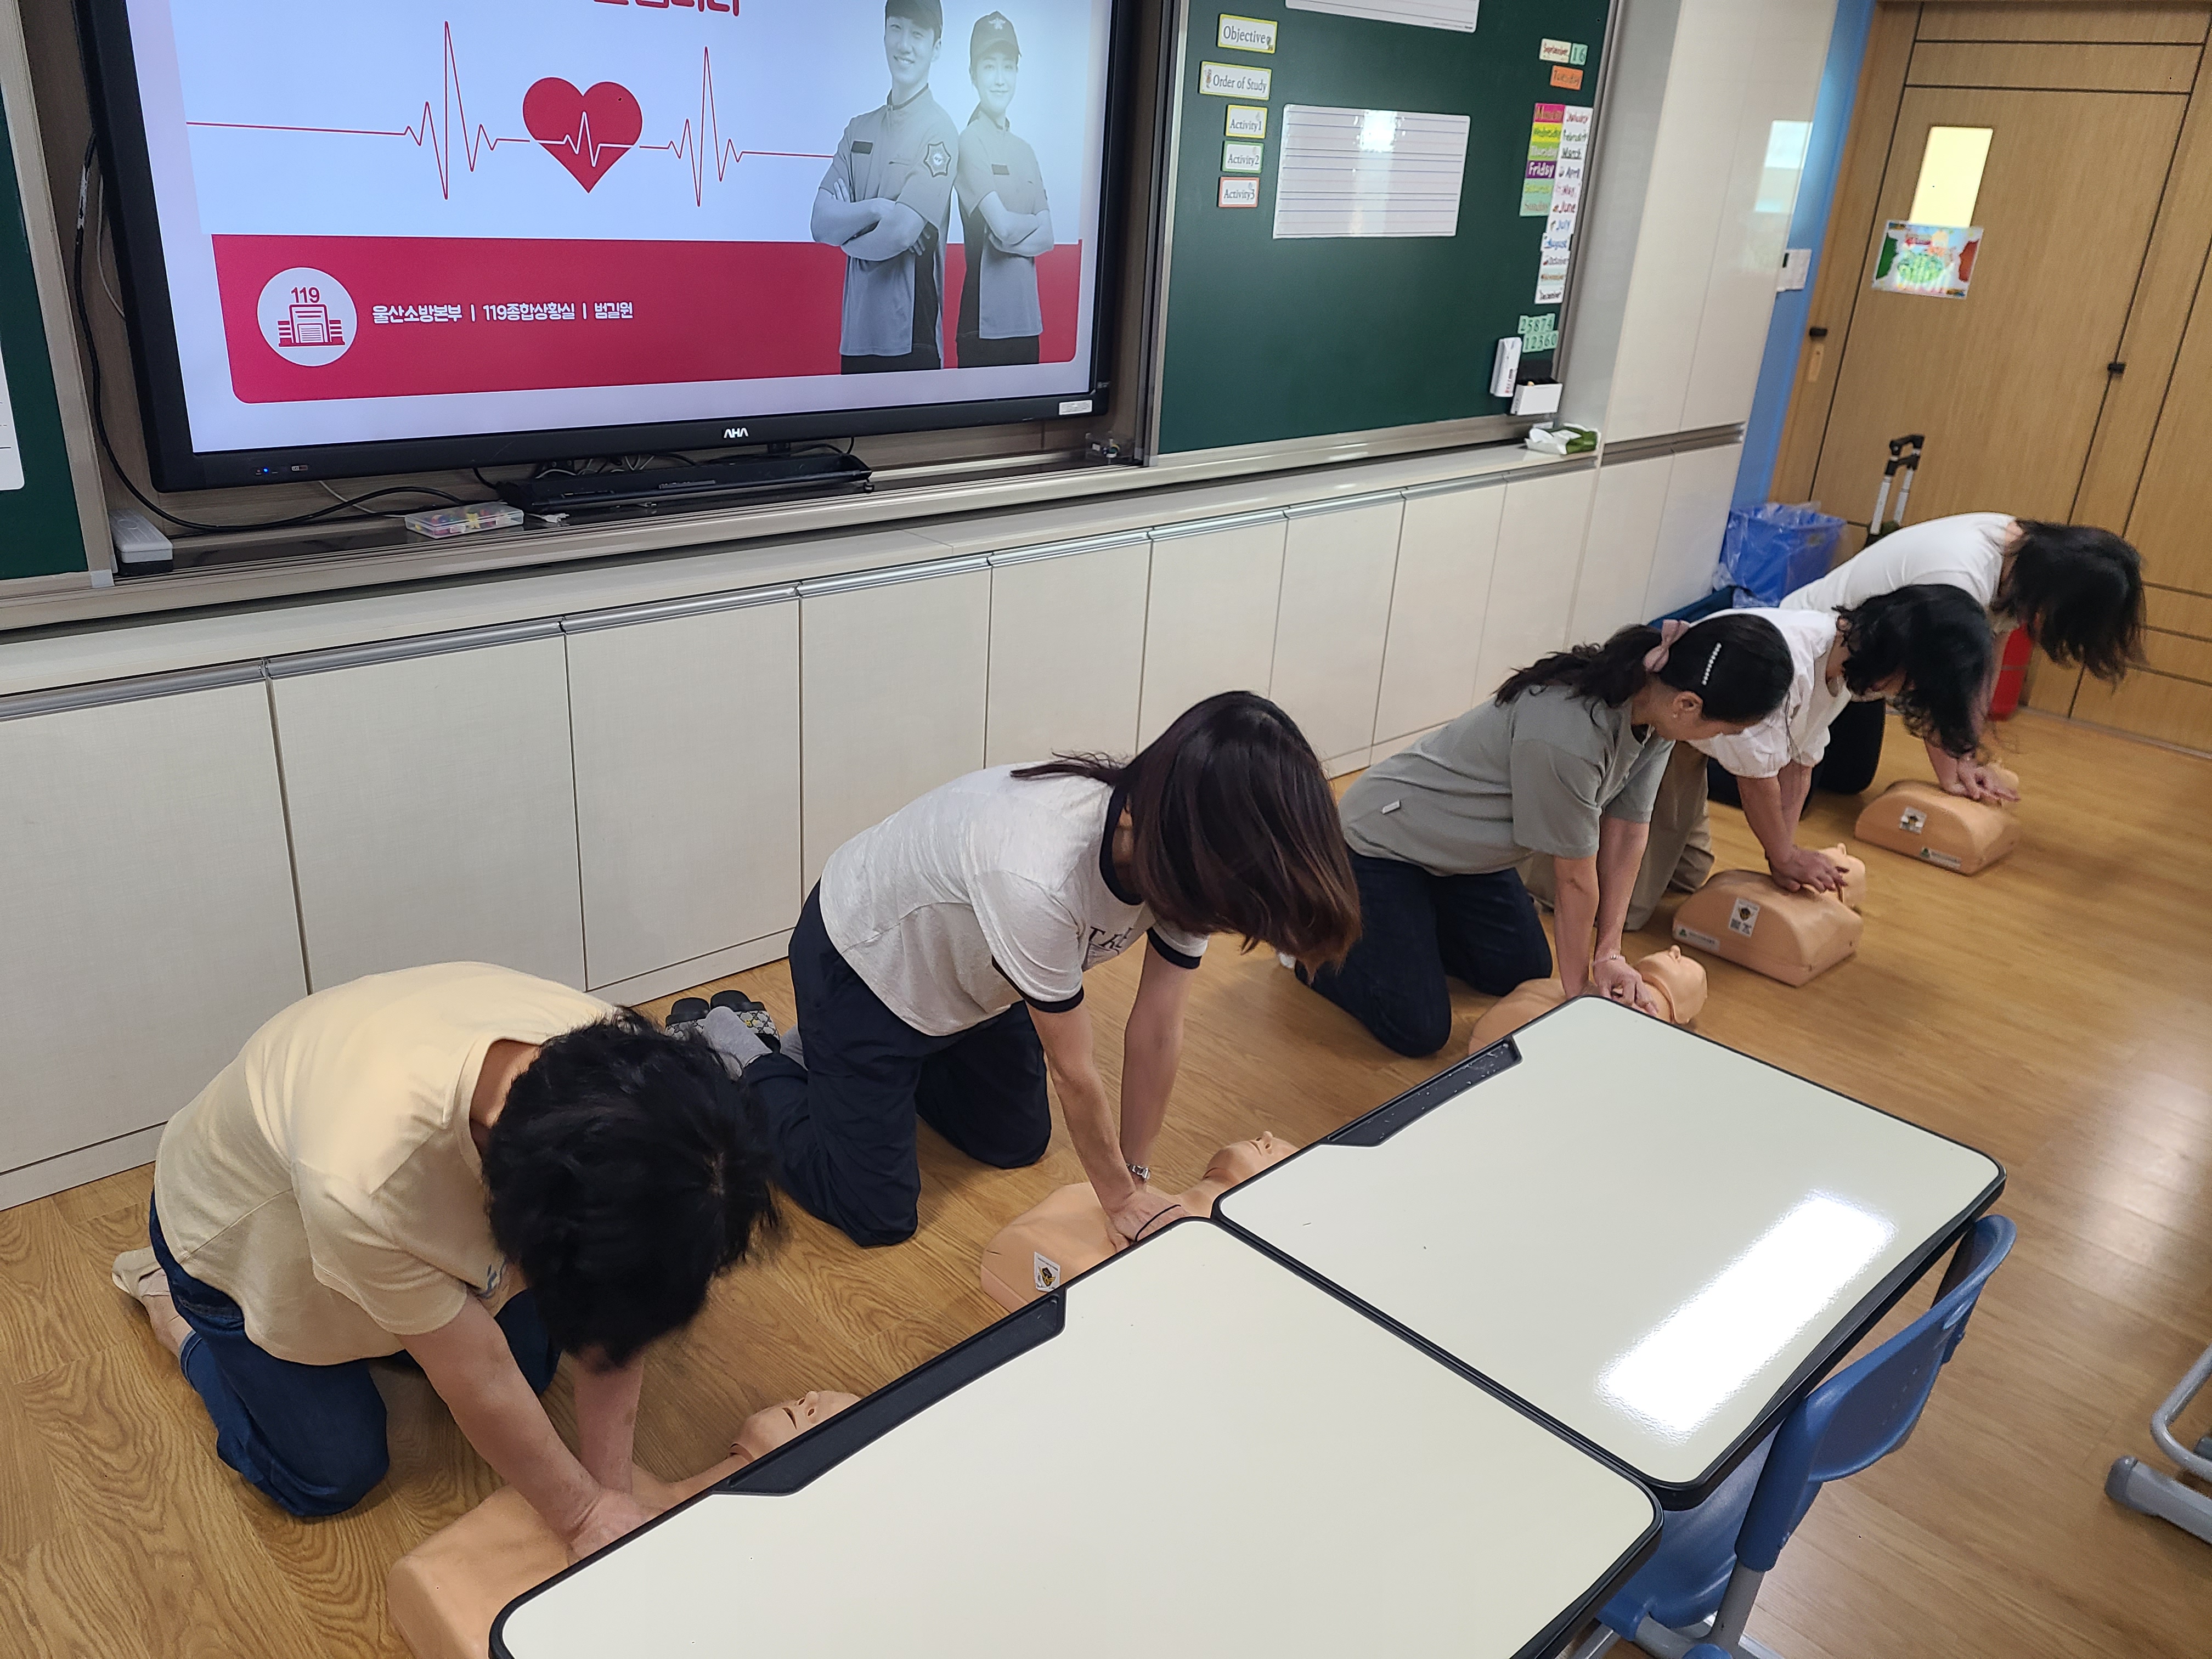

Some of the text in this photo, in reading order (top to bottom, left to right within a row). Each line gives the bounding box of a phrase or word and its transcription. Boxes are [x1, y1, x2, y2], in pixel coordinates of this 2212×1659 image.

[1573, 47, 1586, 63] 16
[1212, 74, 1267, 93] Order of Study
[1229, 119, 1262, 132] Activity1
[1227, 154, 1260, 167] Activity2
[1528, 161, 1555, 178] Friday
[1223, 189, 1255, 201] Activity3
[291, 287, 320, 303] 119
[372, 304, 462, 324] 울산소방본부
[483, 302, 575, 321] 119종합상황실
[594, 302, 634, 319] 범길원
[723, 427, 749, 438] AHA
